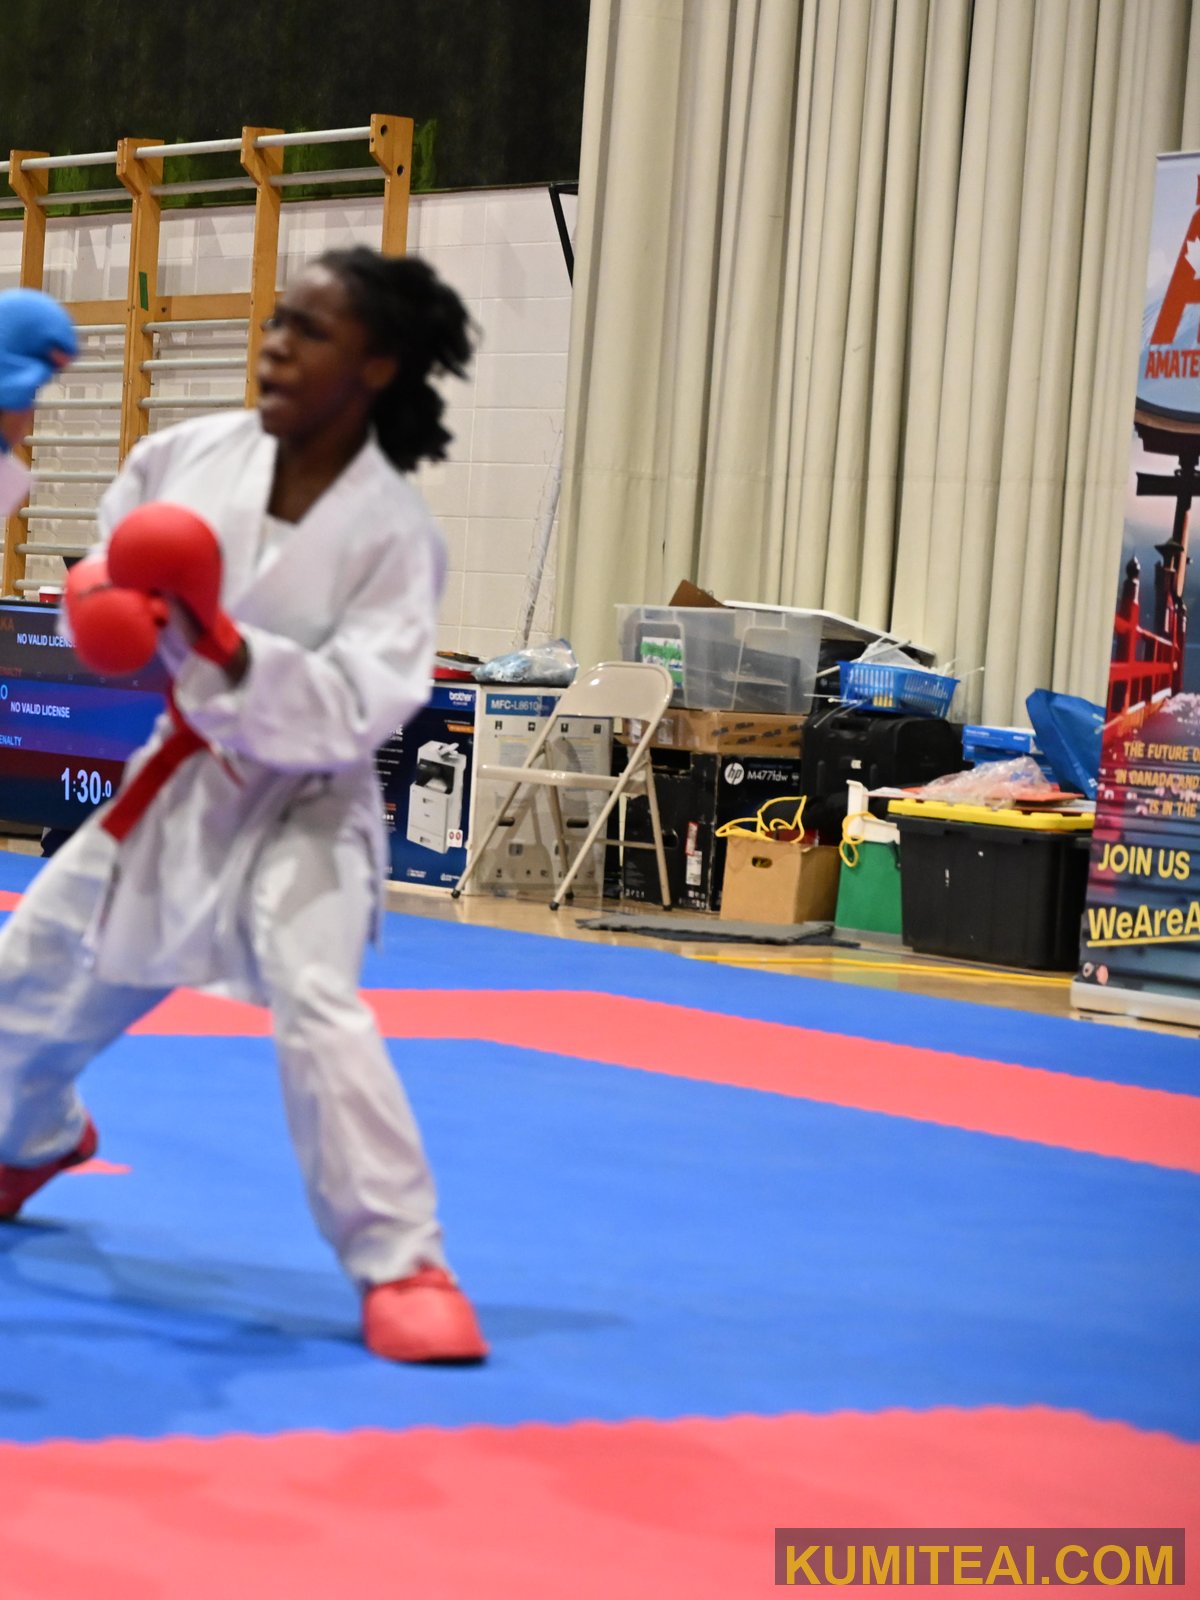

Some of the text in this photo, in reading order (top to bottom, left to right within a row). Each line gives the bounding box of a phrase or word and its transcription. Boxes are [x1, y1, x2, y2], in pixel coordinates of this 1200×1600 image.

[17, 633, 76, 648] NO VALID LICENS
[10, 701, 70, 718] NO VALID LICENSE
[1123, 741, 1145, 758] THE
[1147, 743, 1188, 761] FUTURE
[1129, 770, 1174, 788] CANADA
[1149, 800, 1198, 818] IS IN THE
[1098, 843, 1190, 880] JOIN US
